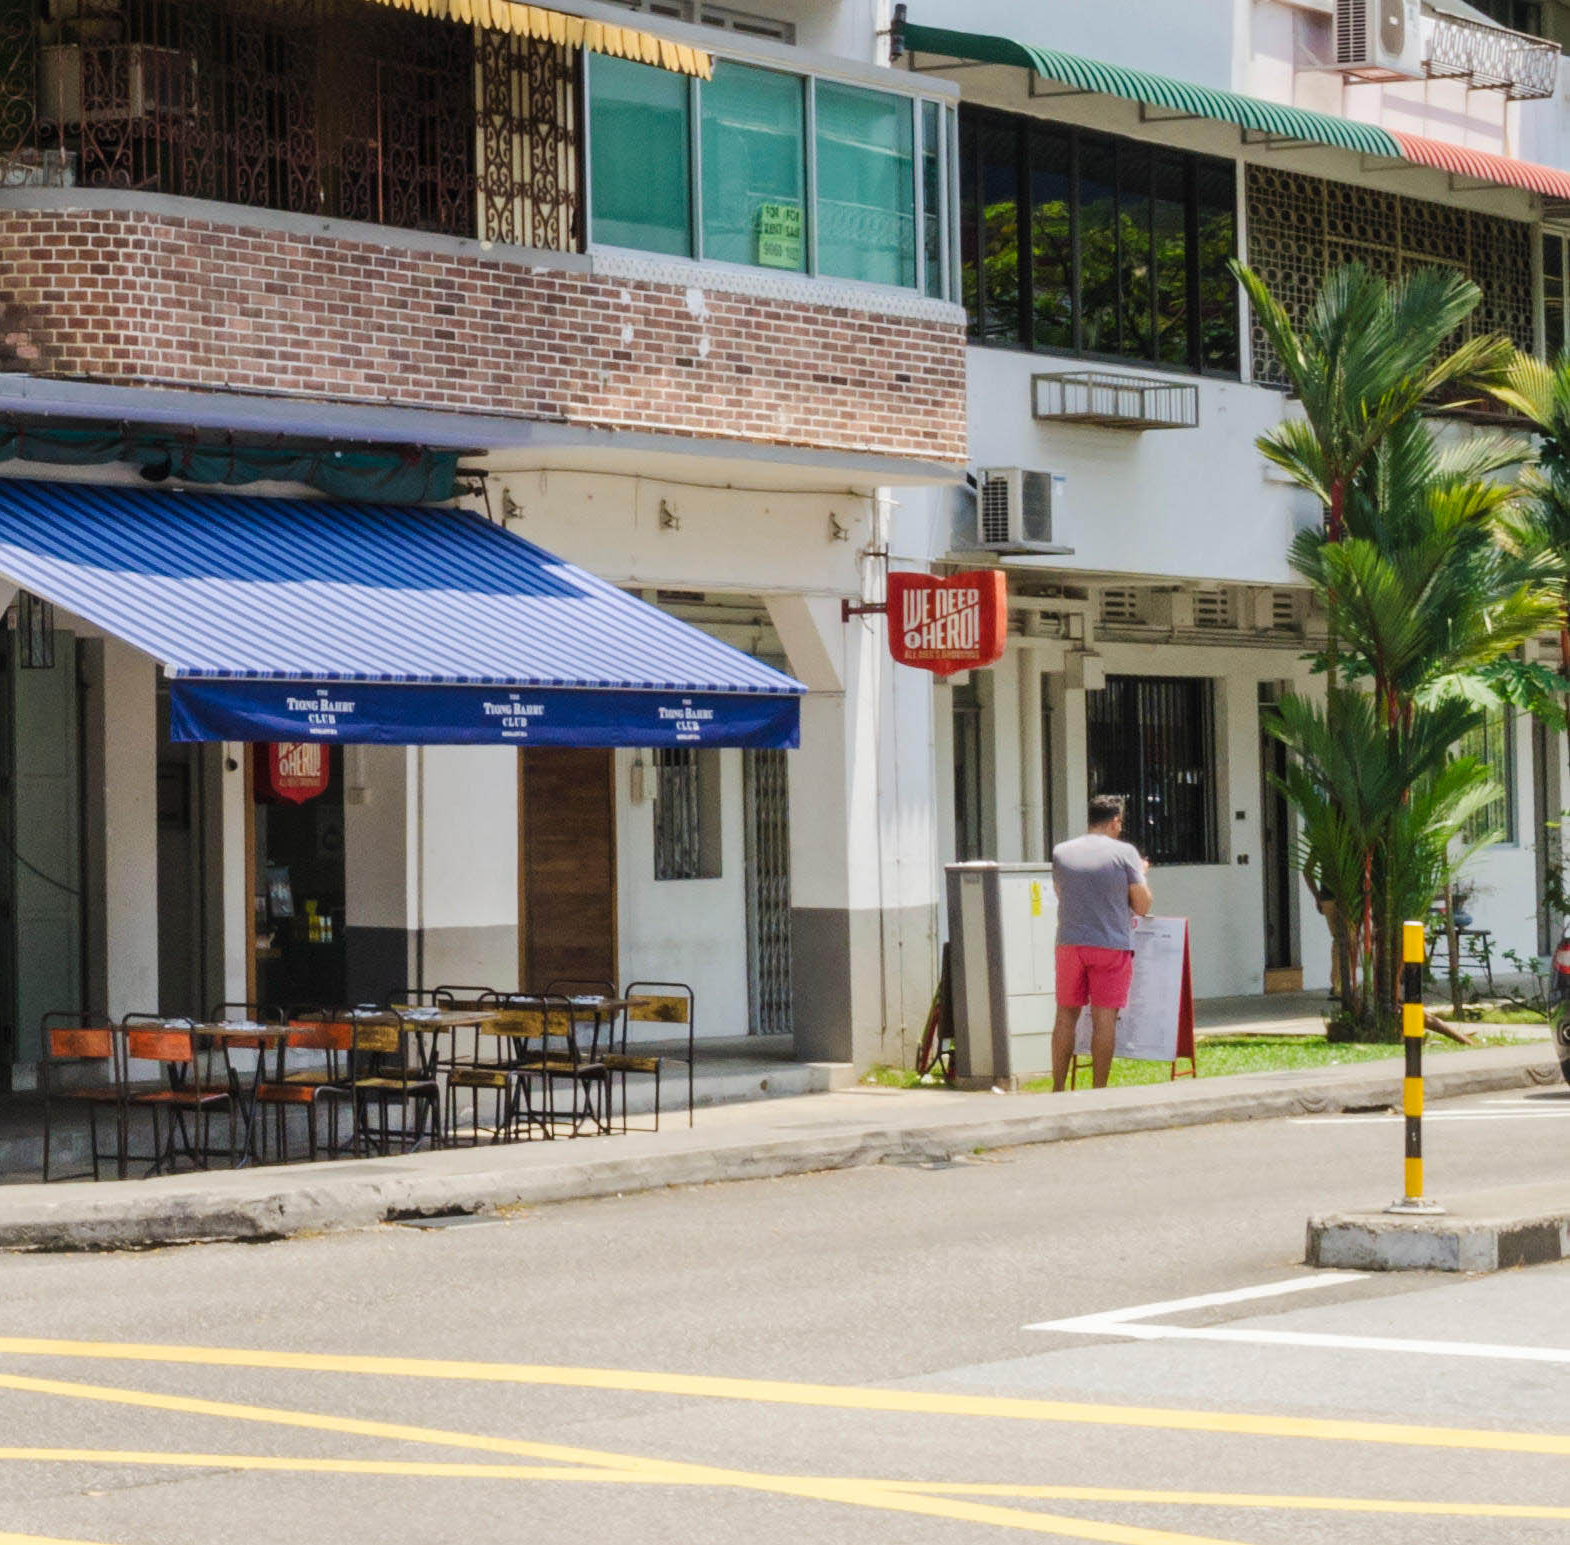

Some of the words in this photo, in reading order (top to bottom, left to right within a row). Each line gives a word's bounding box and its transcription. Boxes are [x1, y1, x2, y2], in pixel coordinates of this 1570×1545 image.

[903, 589, 931, 633] WE
[936, 589, 980, 620] NEED
[922, 604, 980, 649] HERO!
[286, 697, 319, 711] TIONG
[320, 699, 356, 712] BAHRU
[483, 702, 512, 715] TIONG
[308, 714, 336, 724] CLUB
[502, 717, 528, 727] CLUB
[676, 721, 699, 731] CLUB
